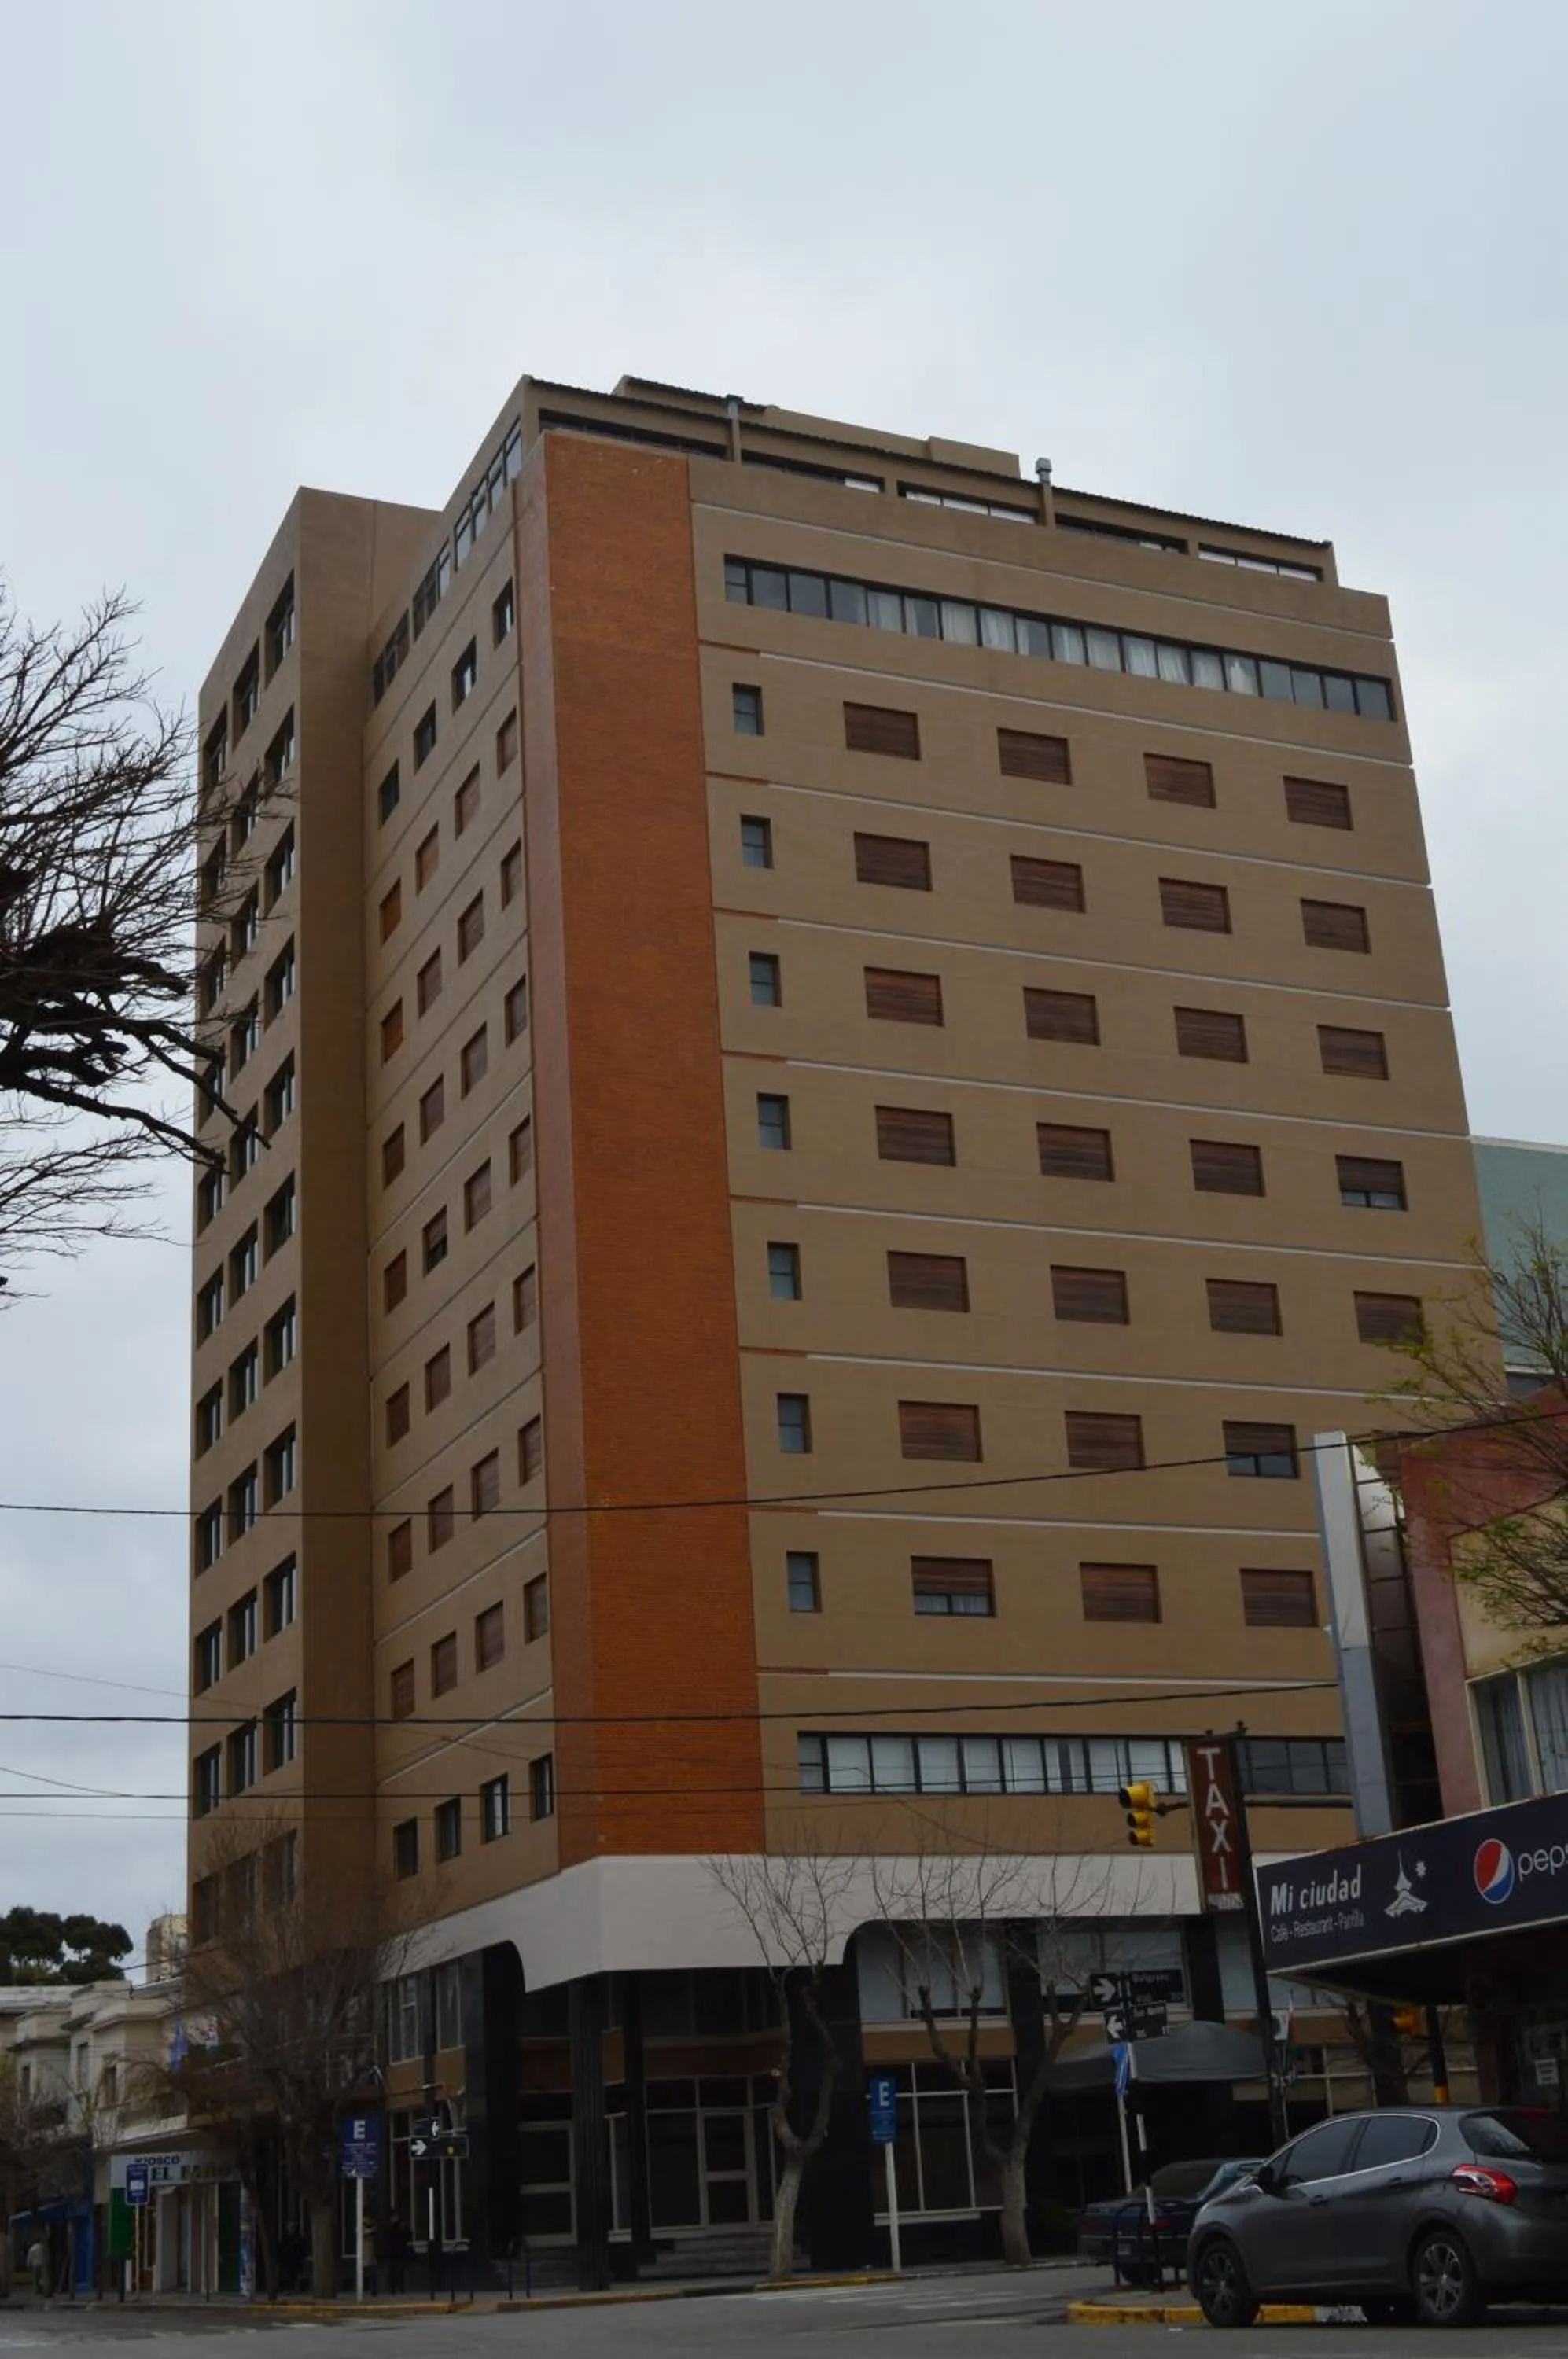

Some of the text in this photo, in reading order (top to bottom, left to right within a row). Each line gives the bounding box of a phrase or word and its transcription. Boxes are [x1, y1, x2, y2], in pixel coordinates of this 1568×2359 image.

[1196, 1747, 1232, 1890] TAXI
[1270, 1882, 1294, 1916] Mi
[1299, 1863, 1362, 1910] ciudad
[1293, 1916, 1334, 1938] Restaurant
[878, 2081, 890, 2107] E
[353, 2119, 366, 2140] E
[151, 2166, 172, 2181] EL
